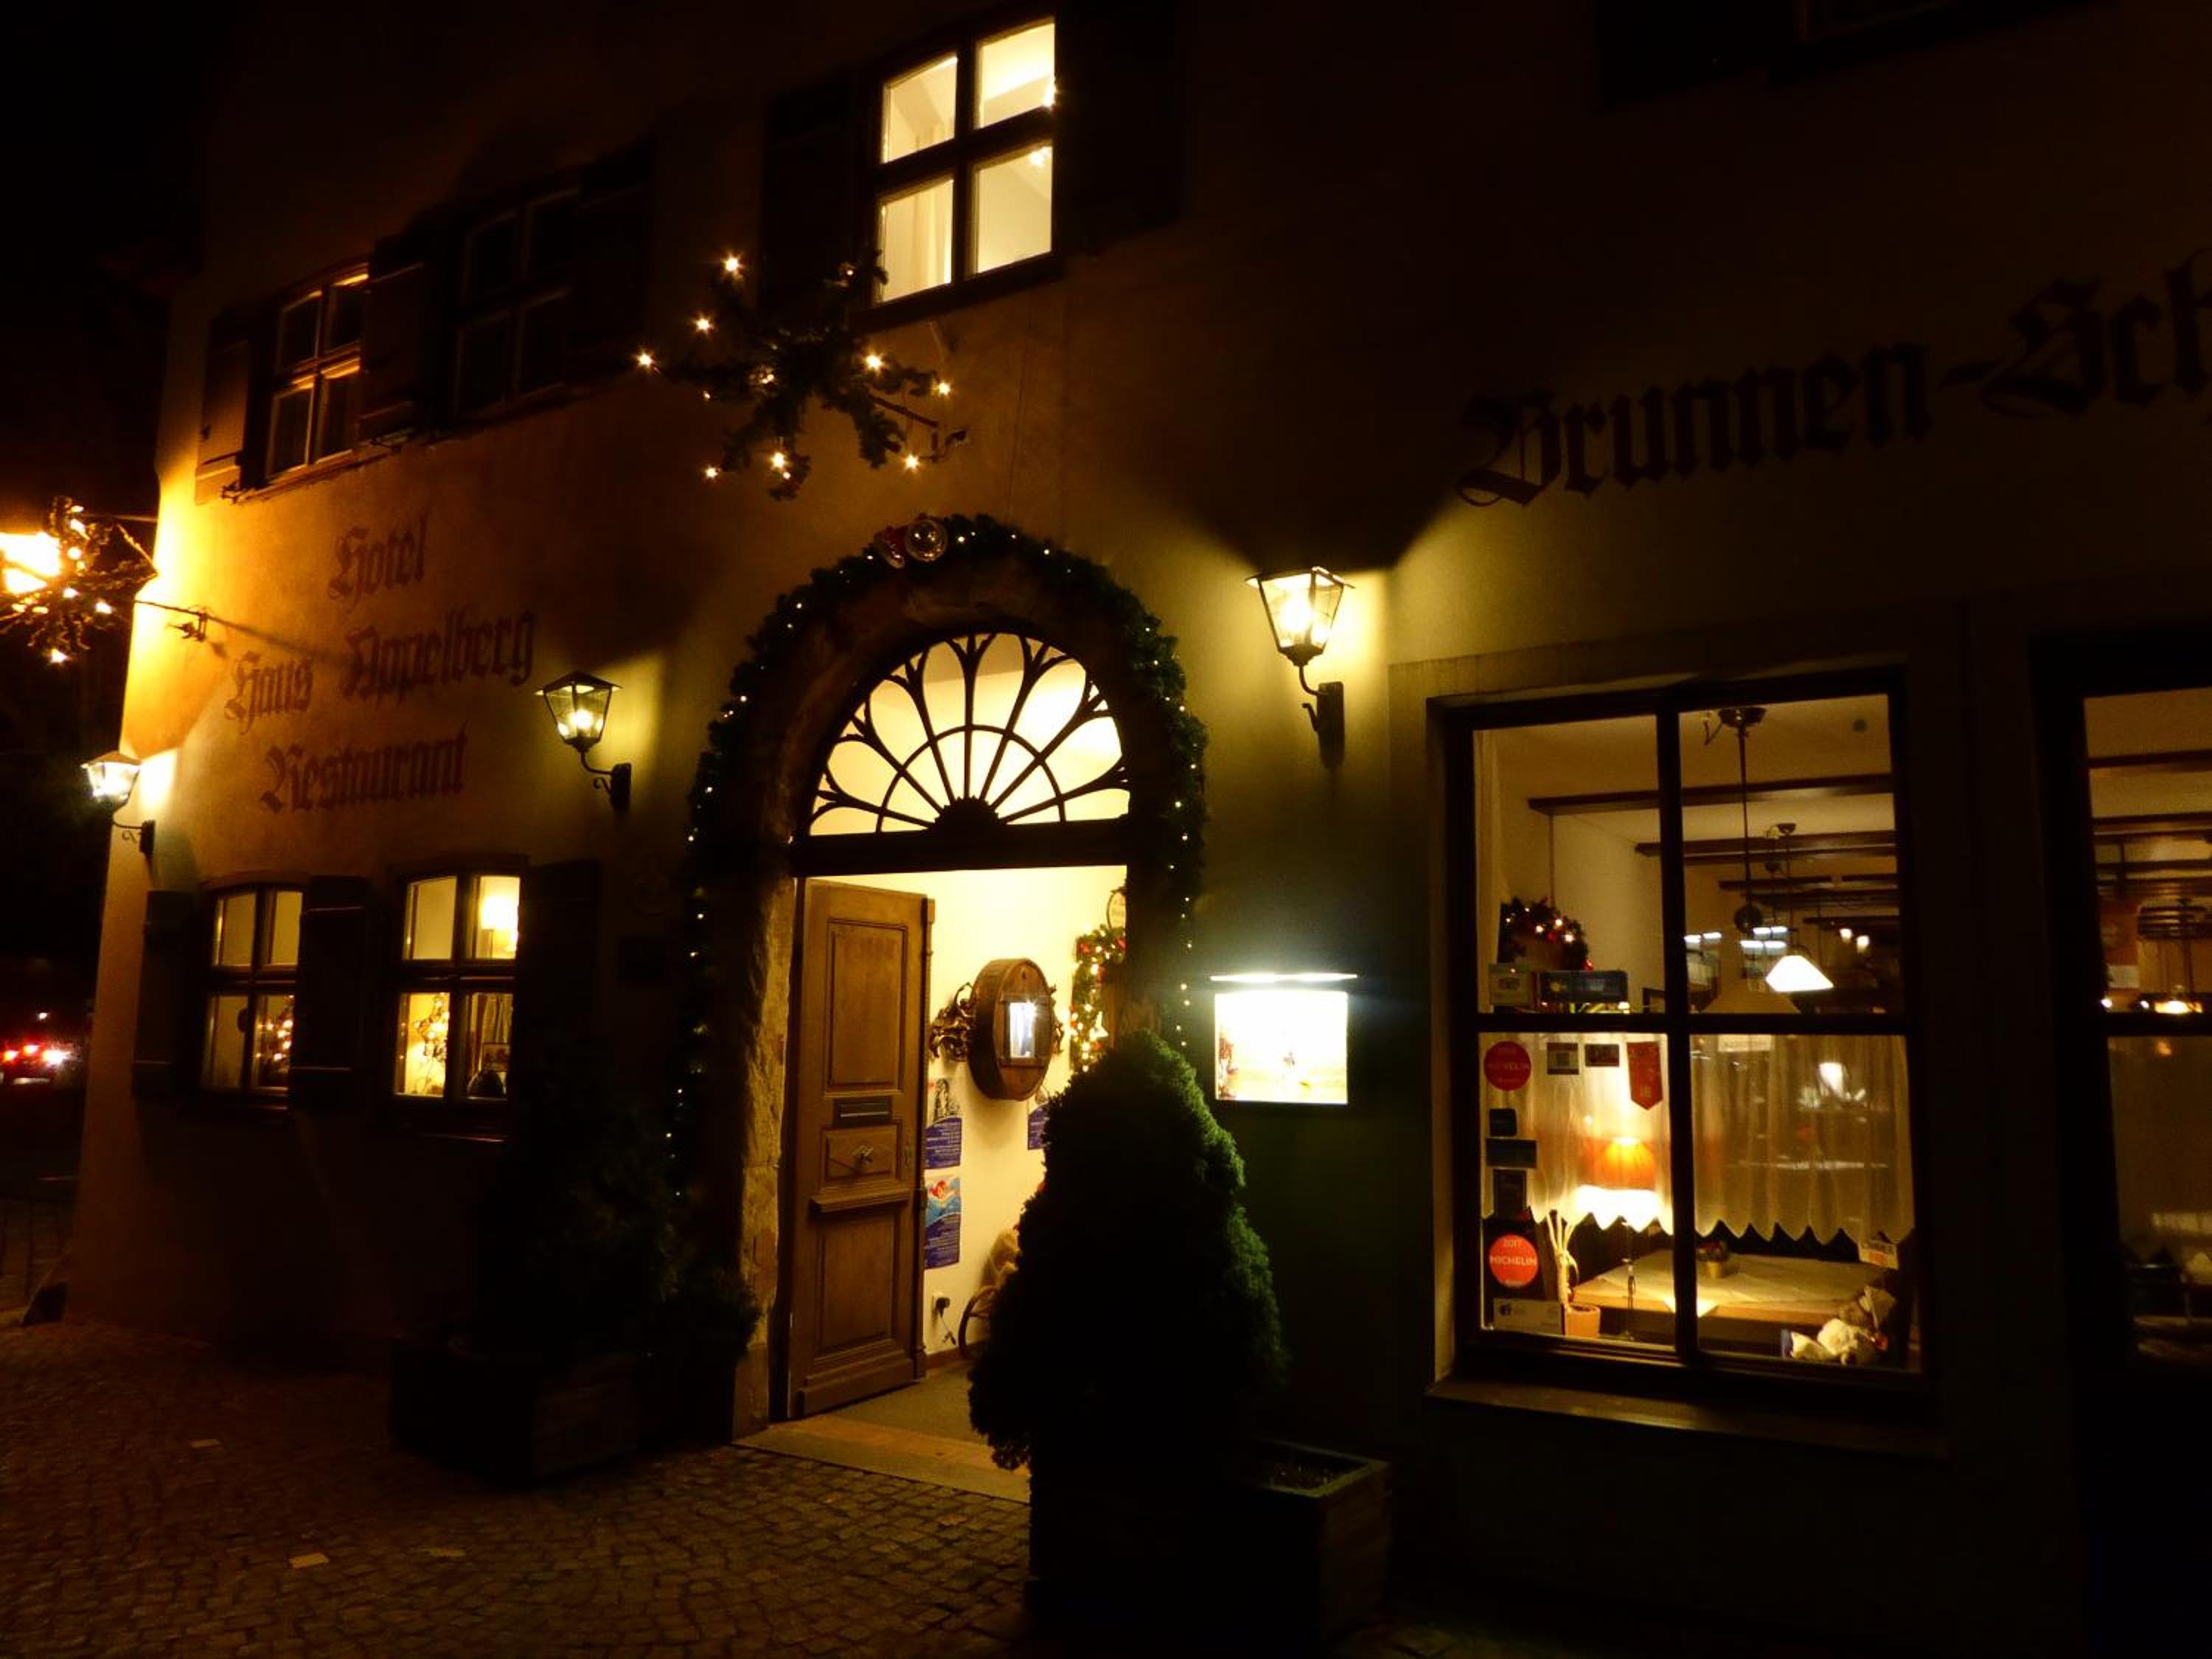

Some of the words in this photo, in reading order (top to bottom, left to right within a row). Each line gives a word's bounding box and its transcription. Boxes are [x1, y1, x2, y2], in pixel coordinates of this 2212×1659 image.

[328, 509, 430, 606] Hotel
[224, 650, 313, 734] Haus
[335, 603, 537, 709] Appelberg
[261, 721, 470, 812] Restaurant
[1489, 1255, 1538, 1266] MICHELIN
